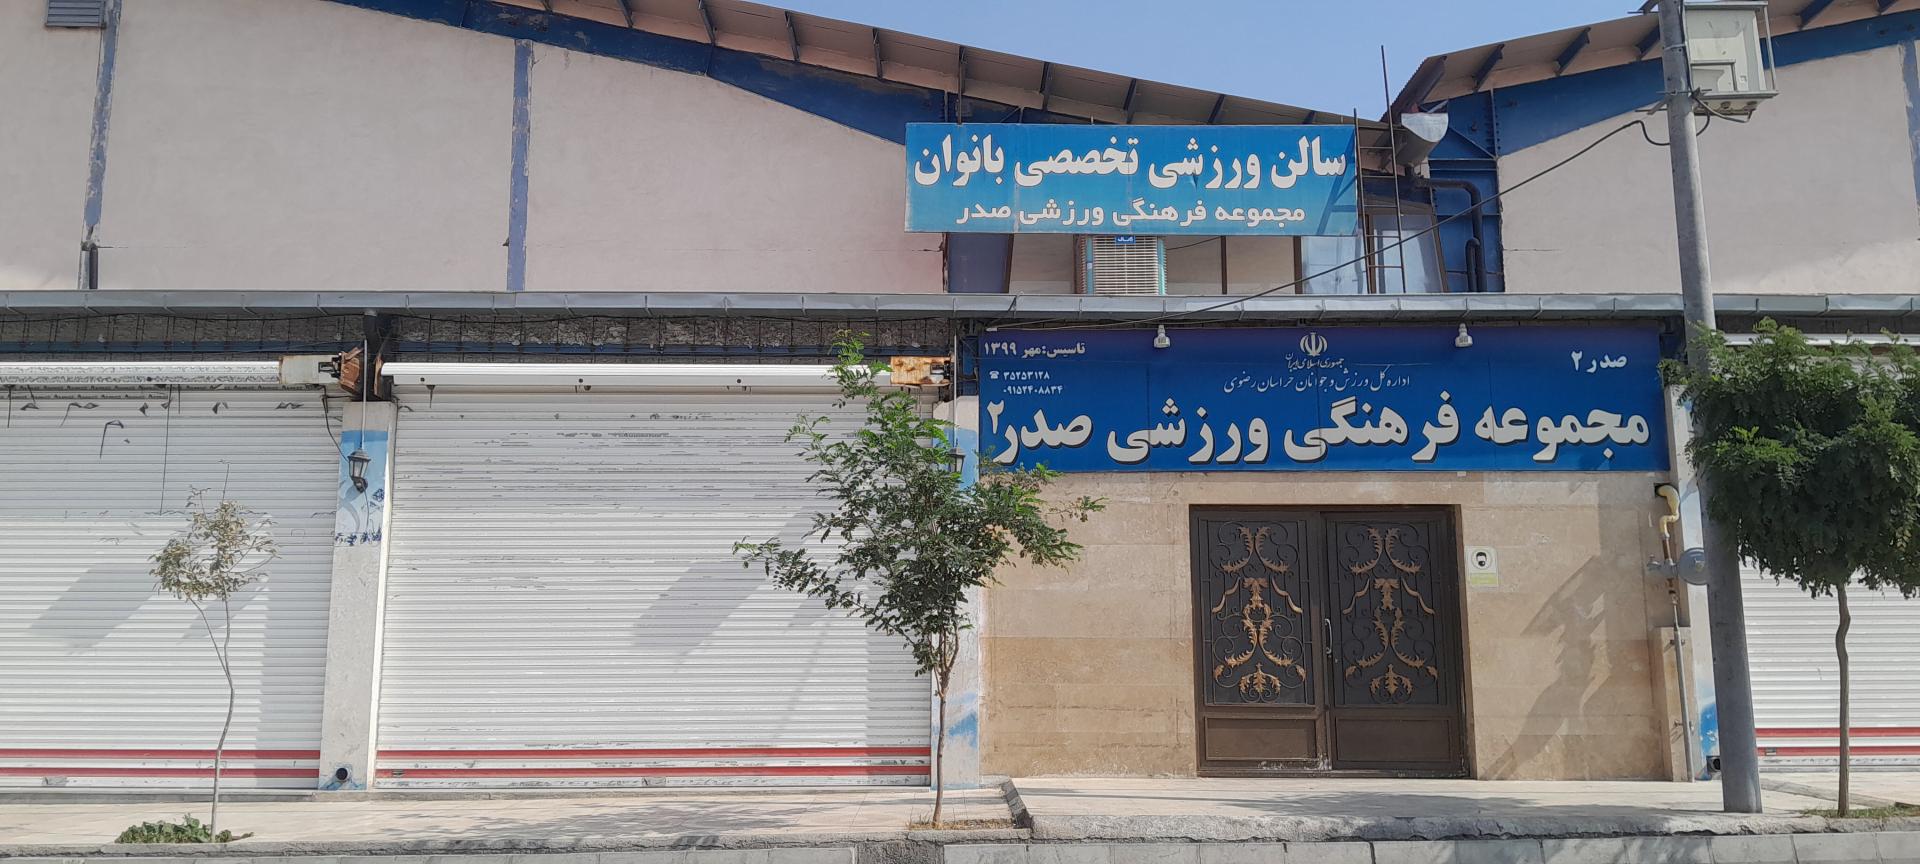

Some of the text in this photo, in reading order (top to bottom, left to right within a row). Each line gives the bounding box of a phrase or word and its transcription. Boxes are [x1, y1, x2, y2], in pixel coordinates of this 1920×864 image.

[914, 134, 1346, 189] سالن ورزشی تخصصی بانوان
[956, 197, 1306, 228] مجموعه فرهنگی ورزشی صدر
[984, 341, 1017, 356] ۱۳۹۹
[1320, 357, 1345, 370] جمهوری
[1571, 350, 1628, 373] صدر ۲
[1223, 363, 1411, 394] اداره کل ورزش و جوانان خراسان رضوی
[1106, 397, 1270, 465] ورزشی
[1283, 391, 1461, 464] فرهنگی
[1474, 404, 1651, 462] مجموعه
